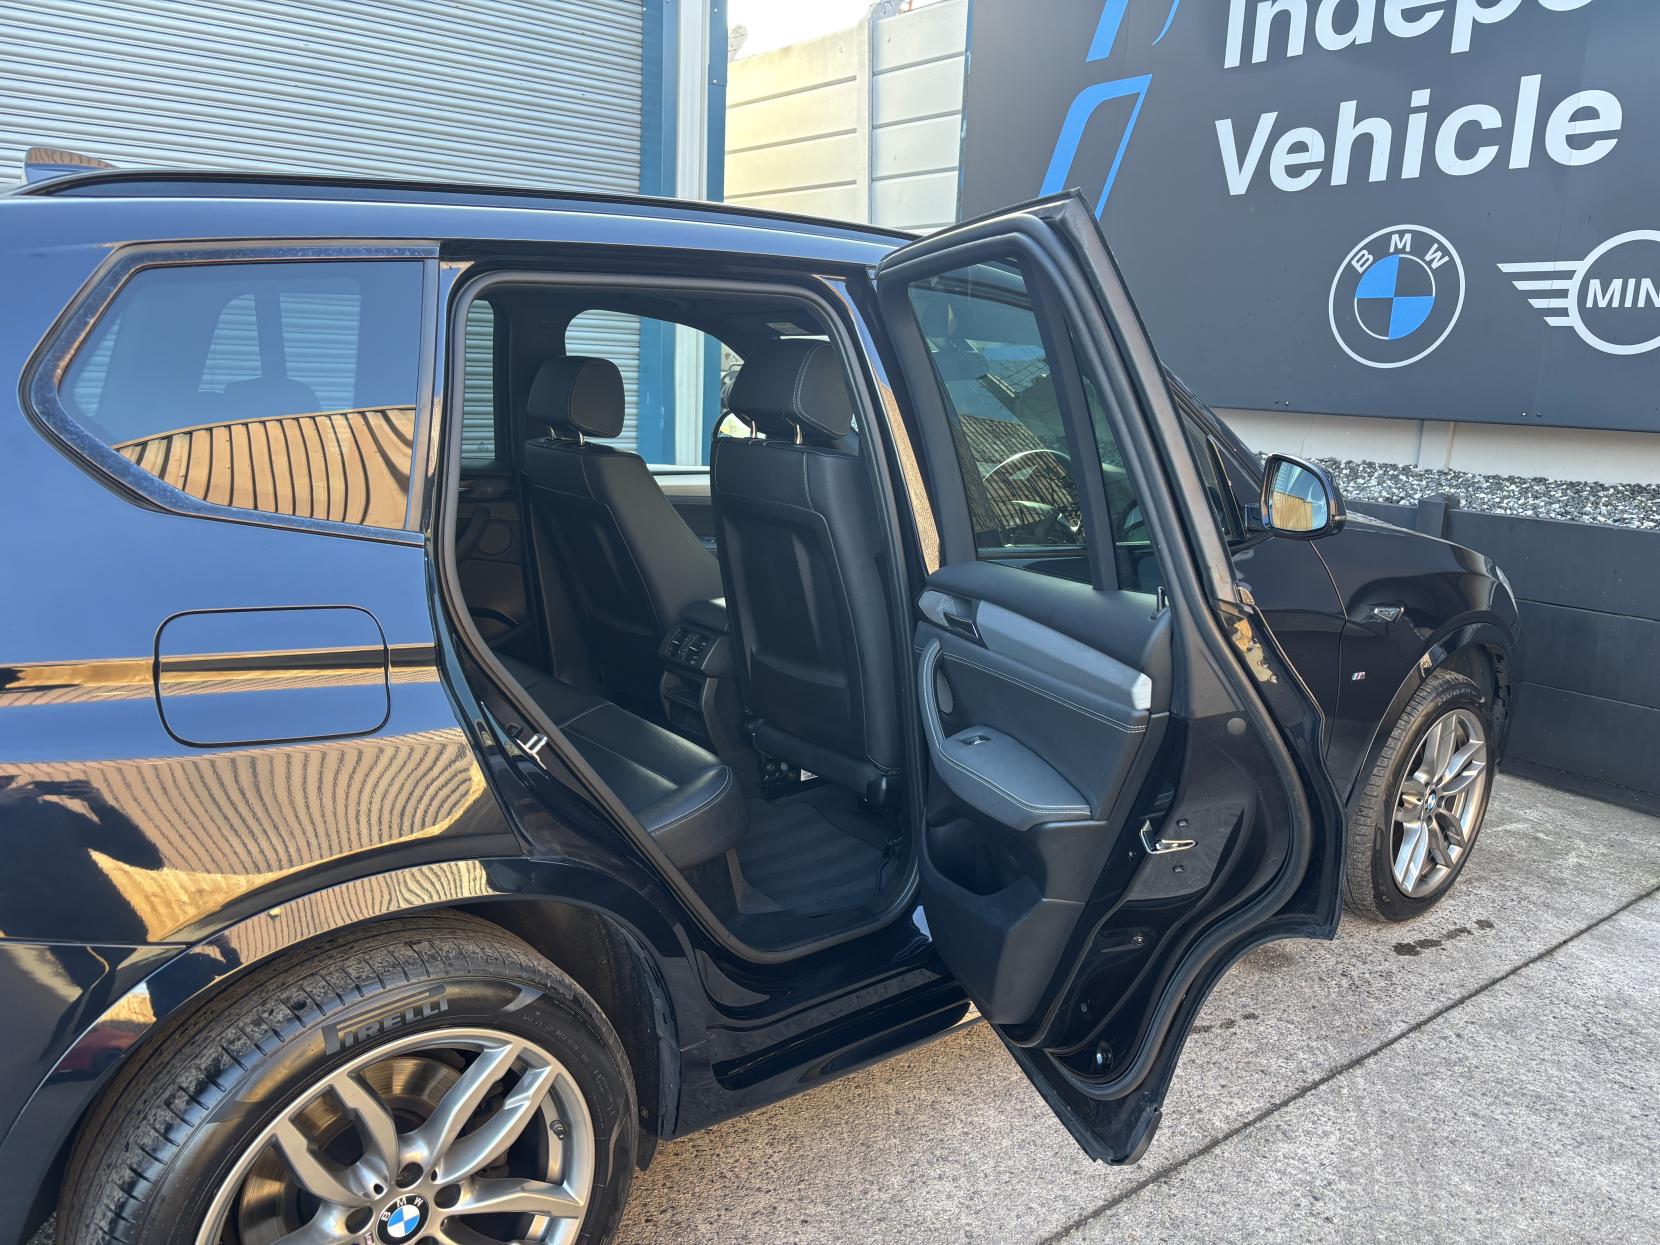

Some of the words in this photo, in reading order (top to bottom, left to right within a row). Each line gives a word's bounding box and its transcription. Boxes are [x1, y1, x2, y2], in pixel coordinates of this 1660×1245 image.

[1223, 0, 1597, 69] Indep
[1214, 73, 1623, 196] Vehicle
[1350, 232, 1450, 274] BMW
[321, 984, 449, 1056] PIRELLI
[381, 1196, 424, 1222] BMW
